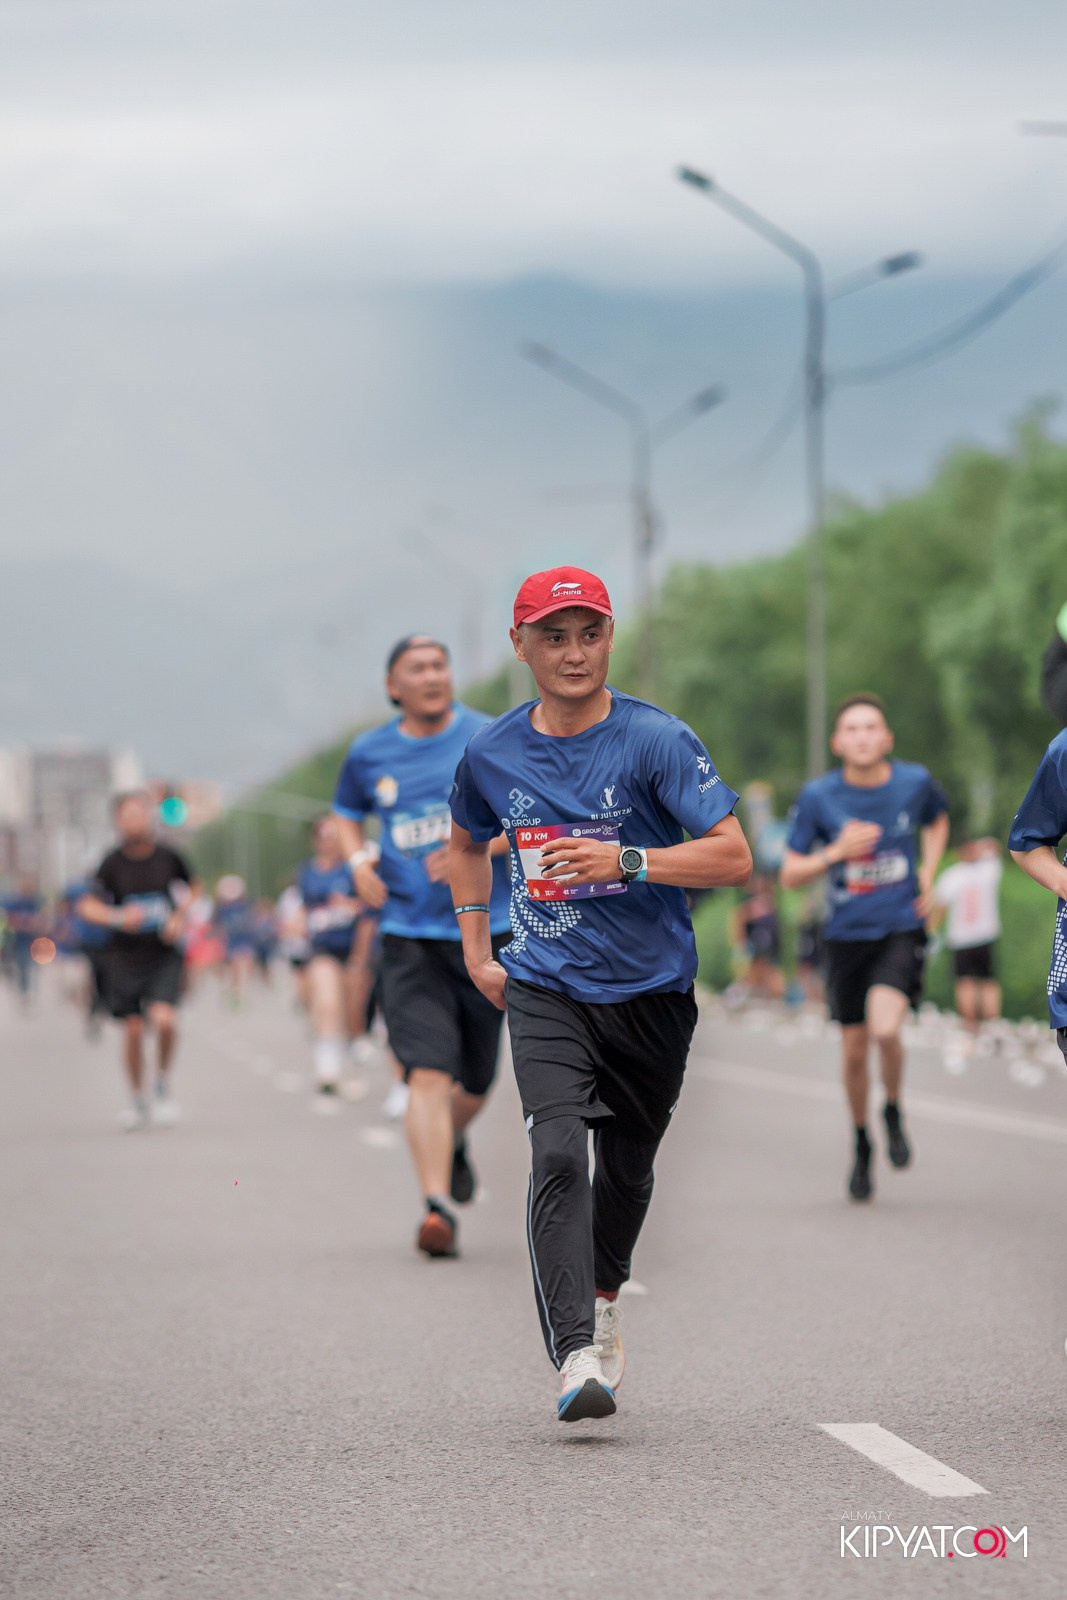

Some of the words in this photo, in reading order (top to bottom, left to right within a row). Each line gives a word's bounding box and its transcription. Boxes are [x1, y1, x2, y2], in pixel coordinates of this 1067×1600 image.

[511, 818, 542, 827] GROUP
[581, 827, 602, 835] GROUP
[520, 831, 532, 842] 10
[534, 832, 548, 841] KM
